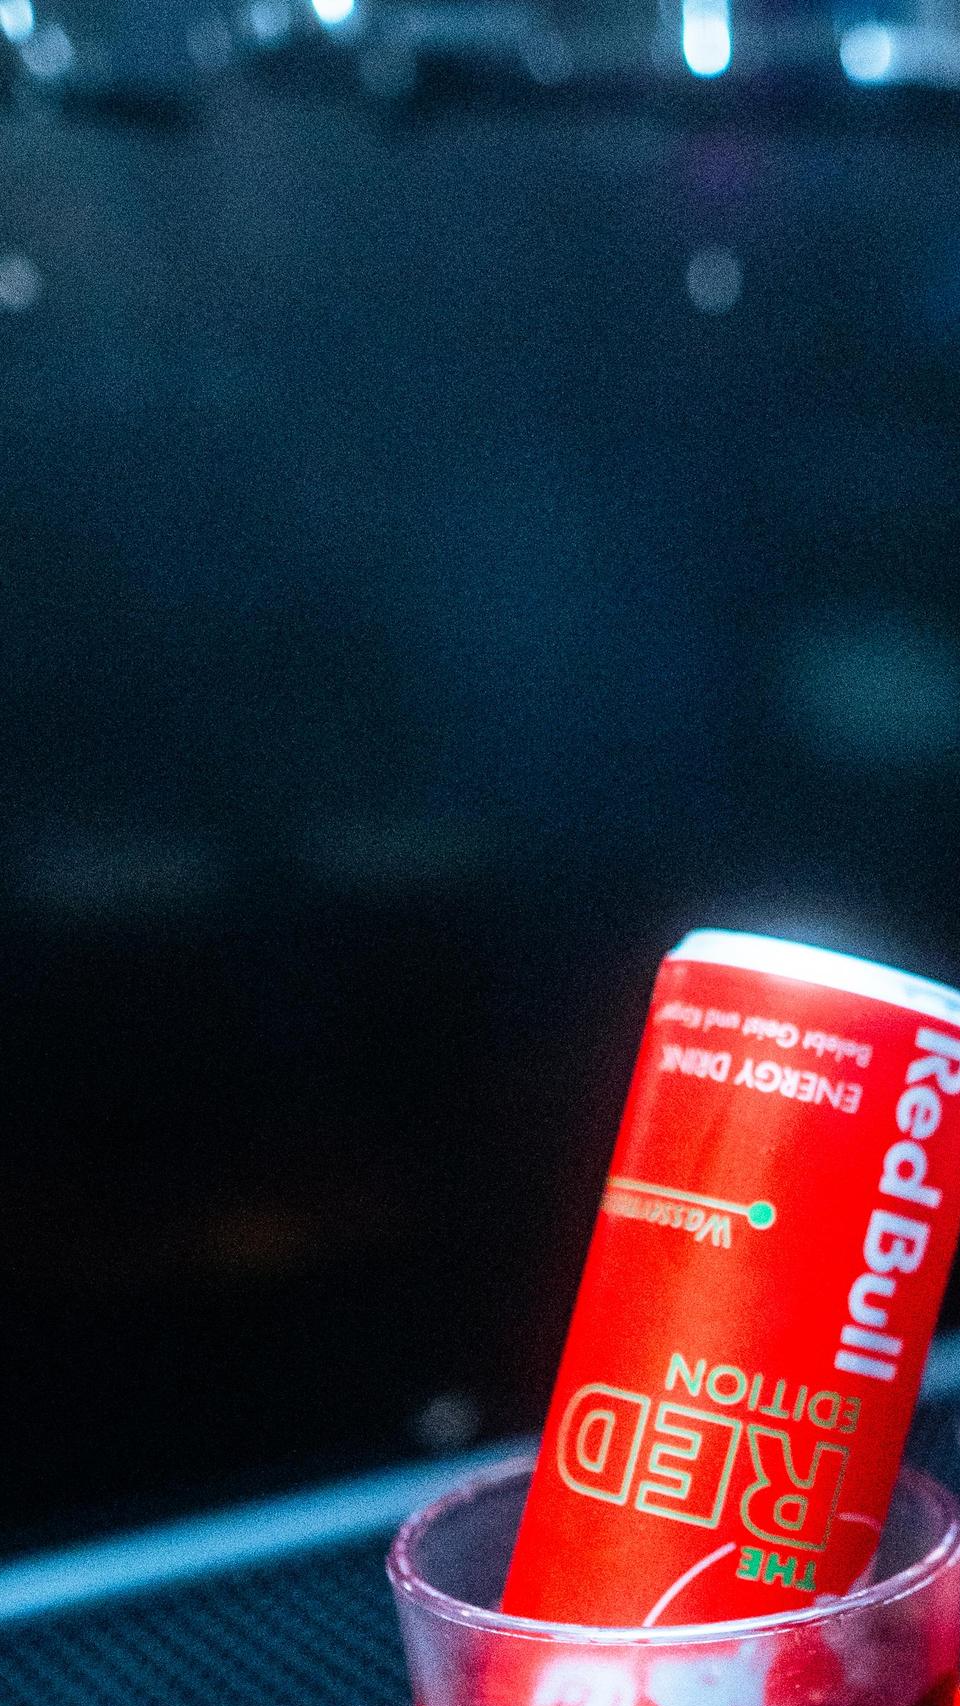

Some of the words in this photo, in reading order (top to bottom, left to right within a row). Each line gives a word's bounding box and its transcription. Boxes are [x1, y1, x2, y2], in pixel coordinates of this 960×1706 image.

[743, 1015, 800, 1048] Geist
[660, 1044, 732, 1083] DRINK
[734, 1057, 864, 1114] ENERGY
[834, 1208, 932, 1382] Bull
[665, 1352, 861, 1434] EDITION
[557, 1382, 850, 1552] RED
[735, 1545, 818, 1592] THE
